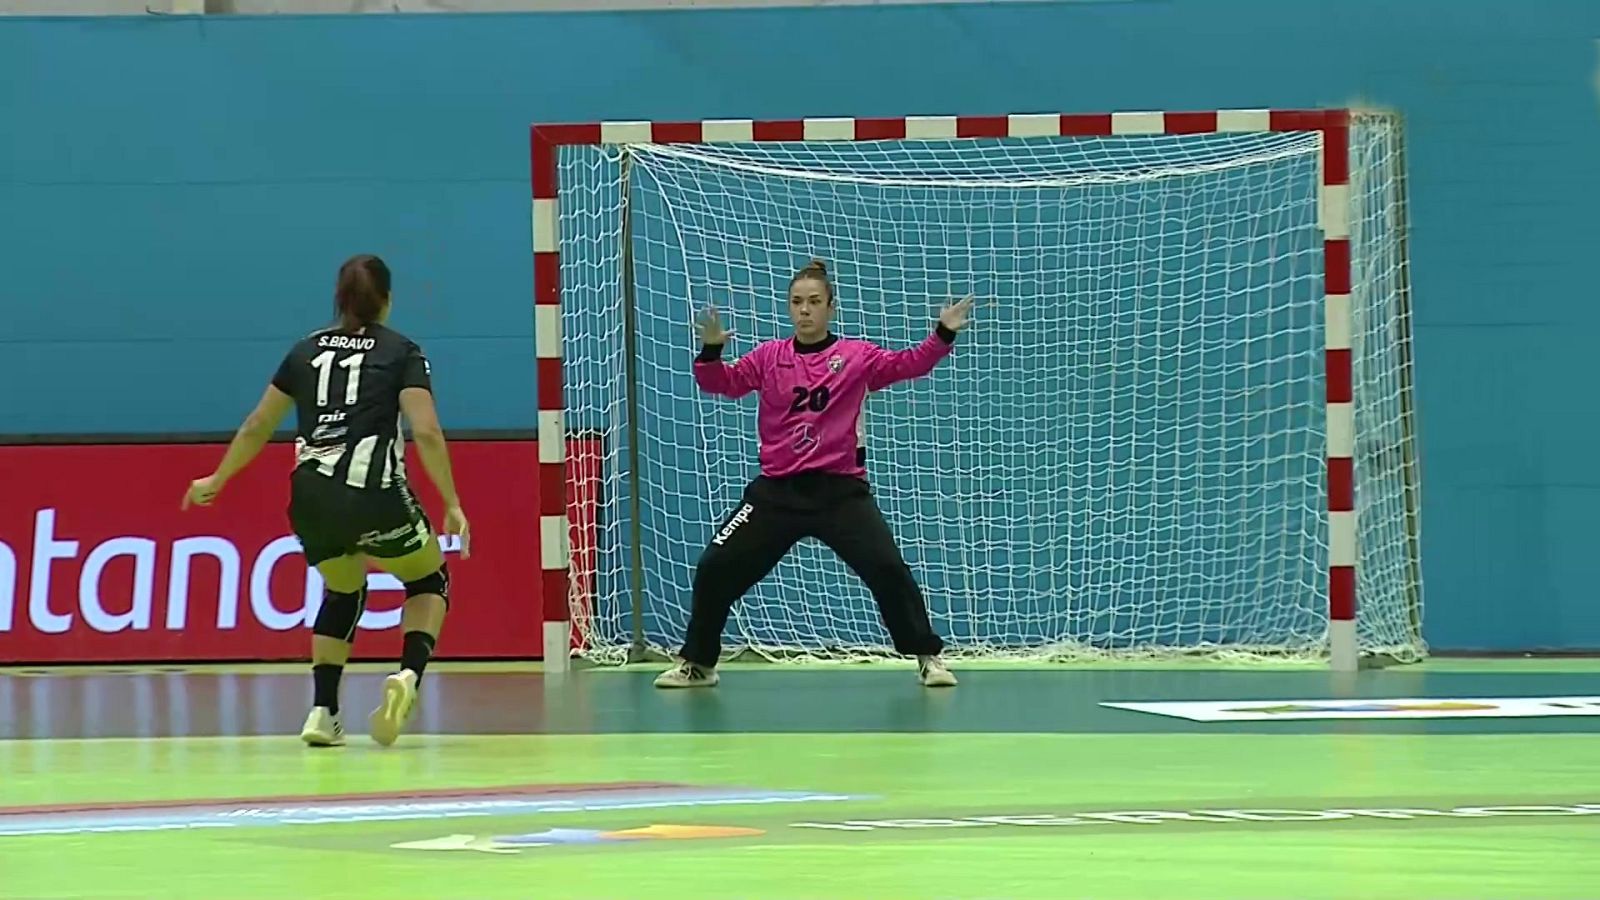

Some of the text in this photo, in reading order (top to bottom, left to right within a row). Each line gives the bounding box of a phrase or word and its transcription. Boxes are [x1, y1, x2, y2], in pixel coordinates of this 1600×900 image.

[318, 335, 376, 350] S.BRAVO
[311, 350, 366, 406] 11
[792, 386, 830, 412] 20
